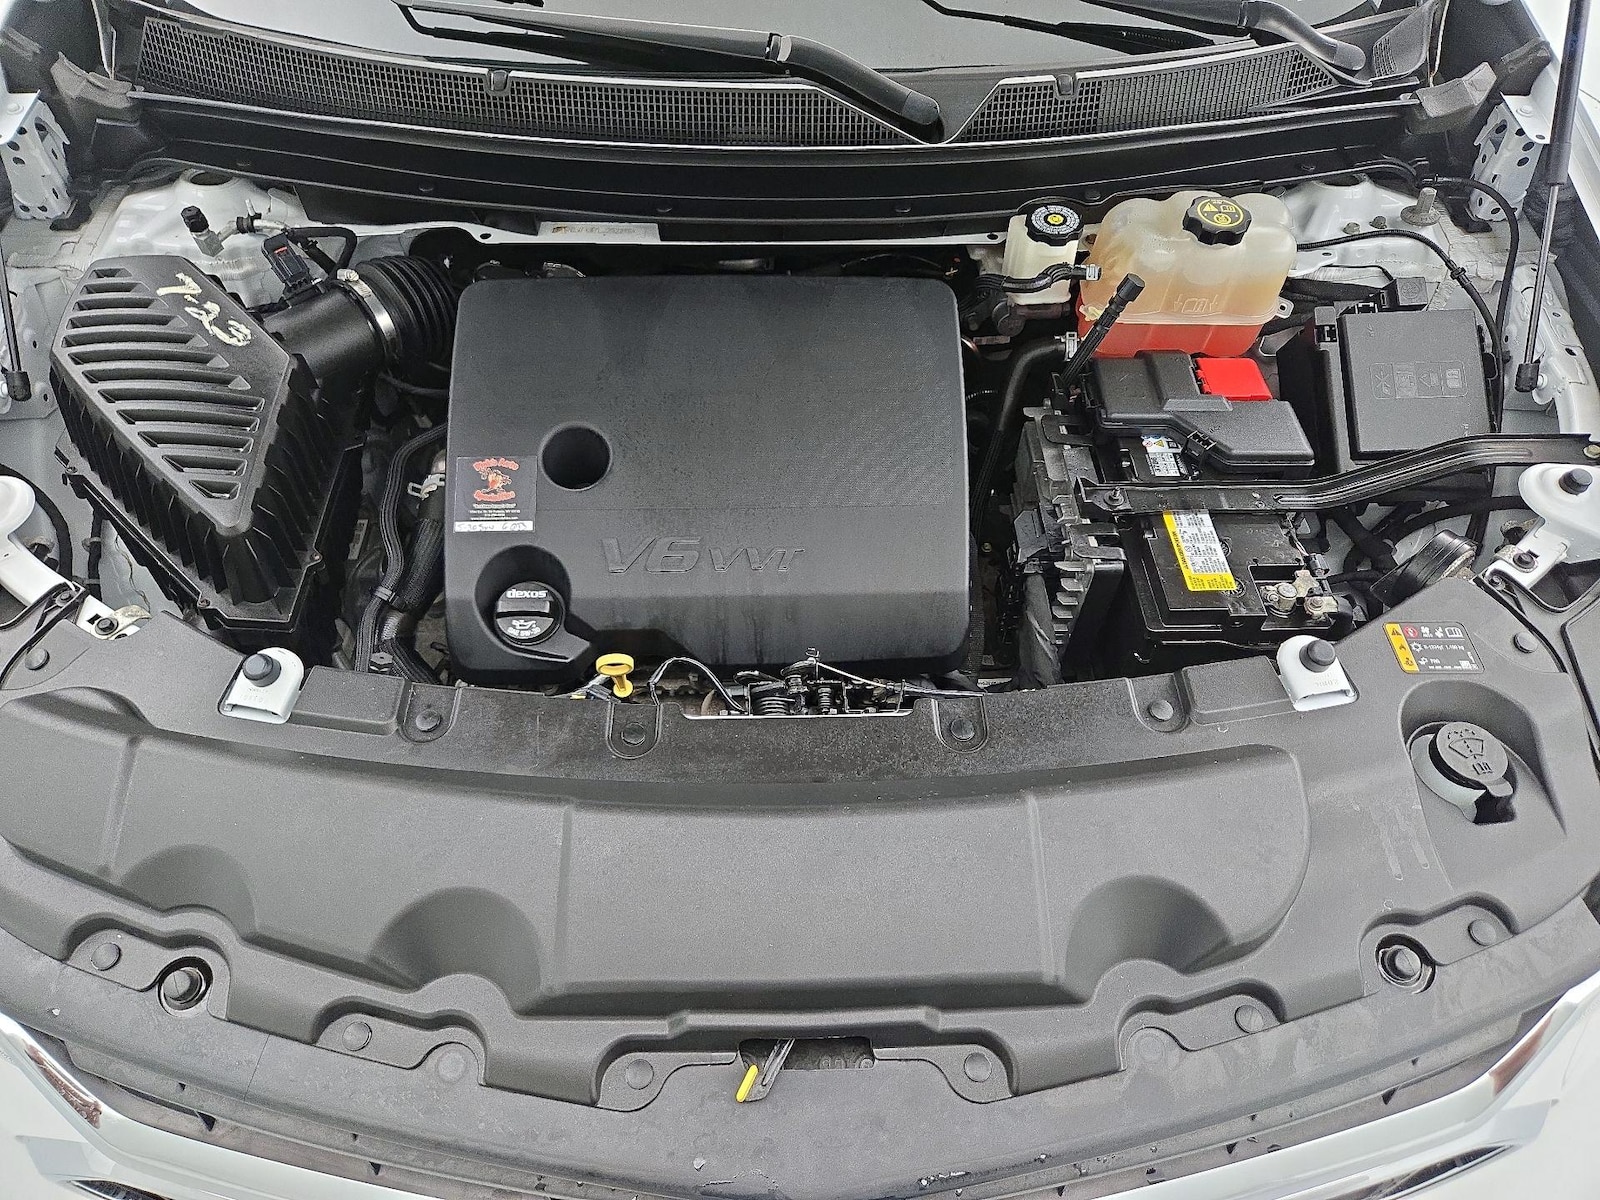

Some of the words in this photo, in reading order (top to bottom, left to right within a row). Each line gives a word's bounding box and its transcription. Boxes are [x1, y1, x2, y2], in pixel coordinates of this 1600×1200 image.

[601, 536, 702, 574] V6
[709, 547, 806, 573] VVT
[506, 588, 548, 598] dexos
